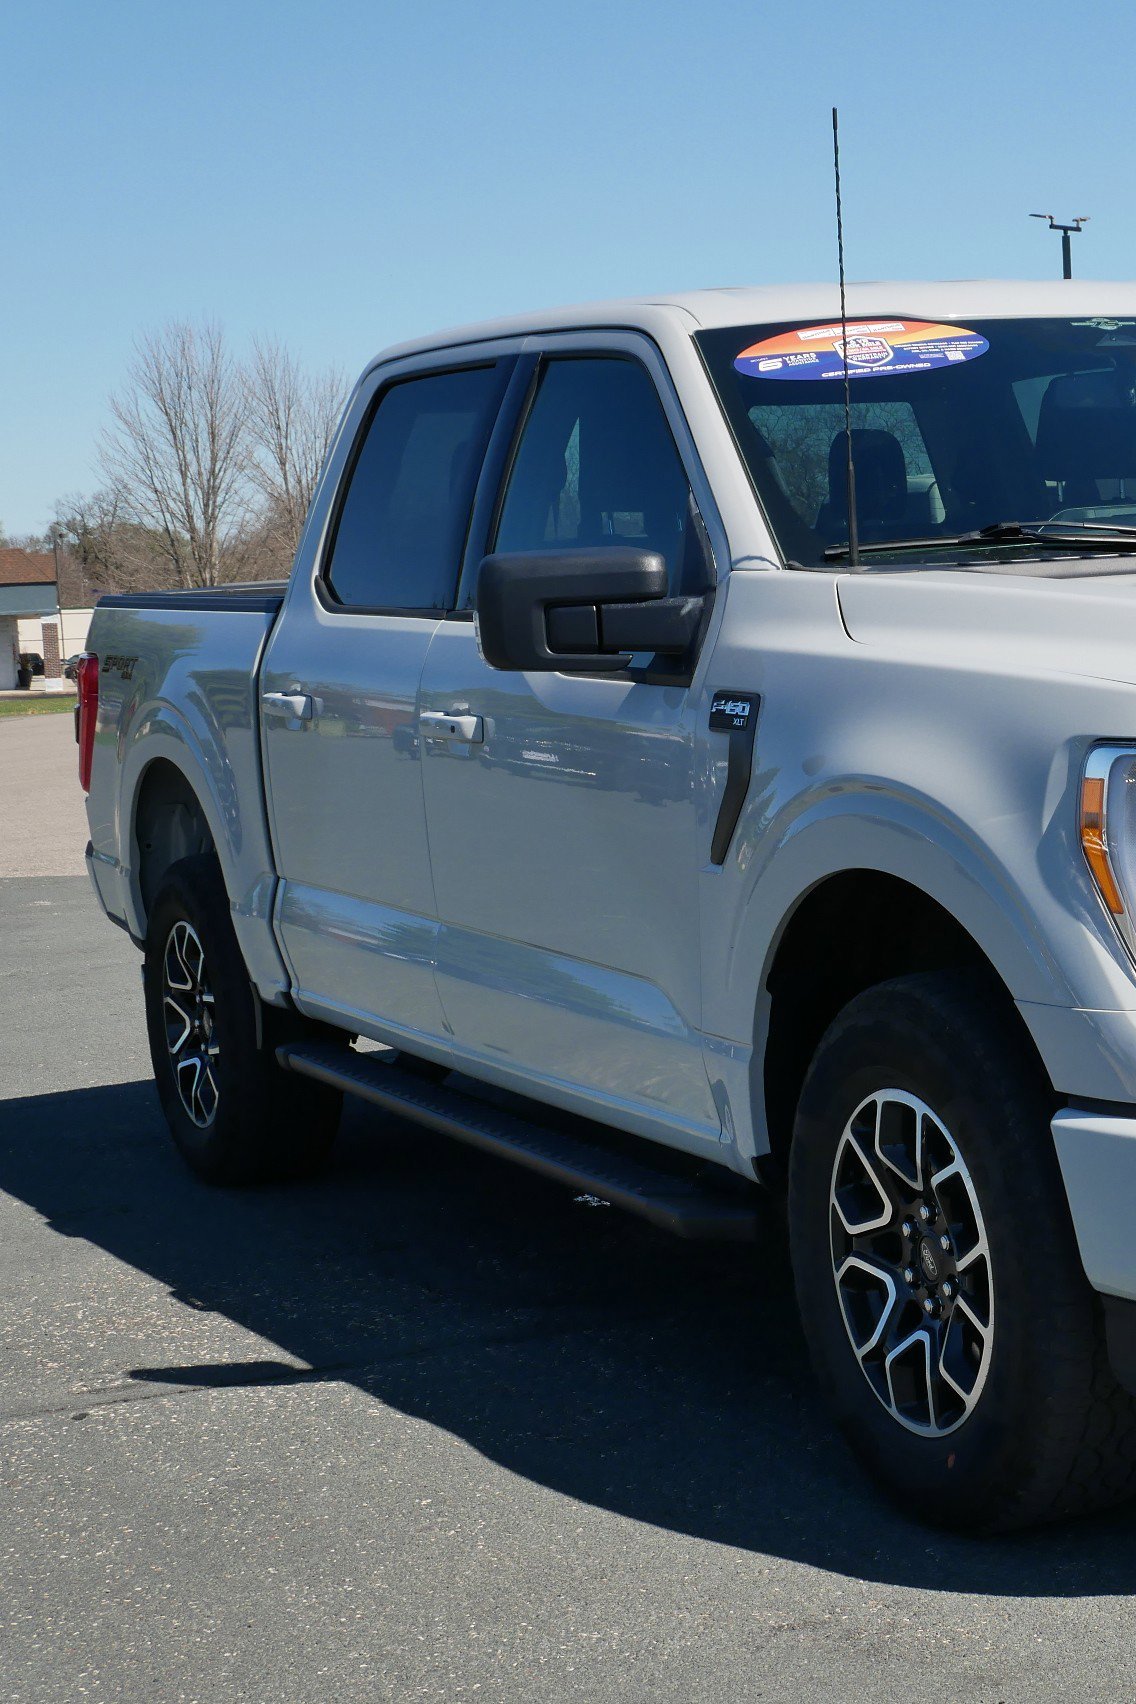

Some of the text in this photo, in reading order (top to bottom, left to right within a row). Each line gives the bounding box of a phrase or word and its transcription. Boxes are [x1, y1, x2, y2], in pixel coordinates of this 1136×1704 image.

[783, 353, 816, 362] YEARS
[759, 358, 782, 371] 6
[873, 363, 931, 372] PRE-OWNED
[102, 655, 139, 672] SPORT
[732, 718, 744, 726] XLT
